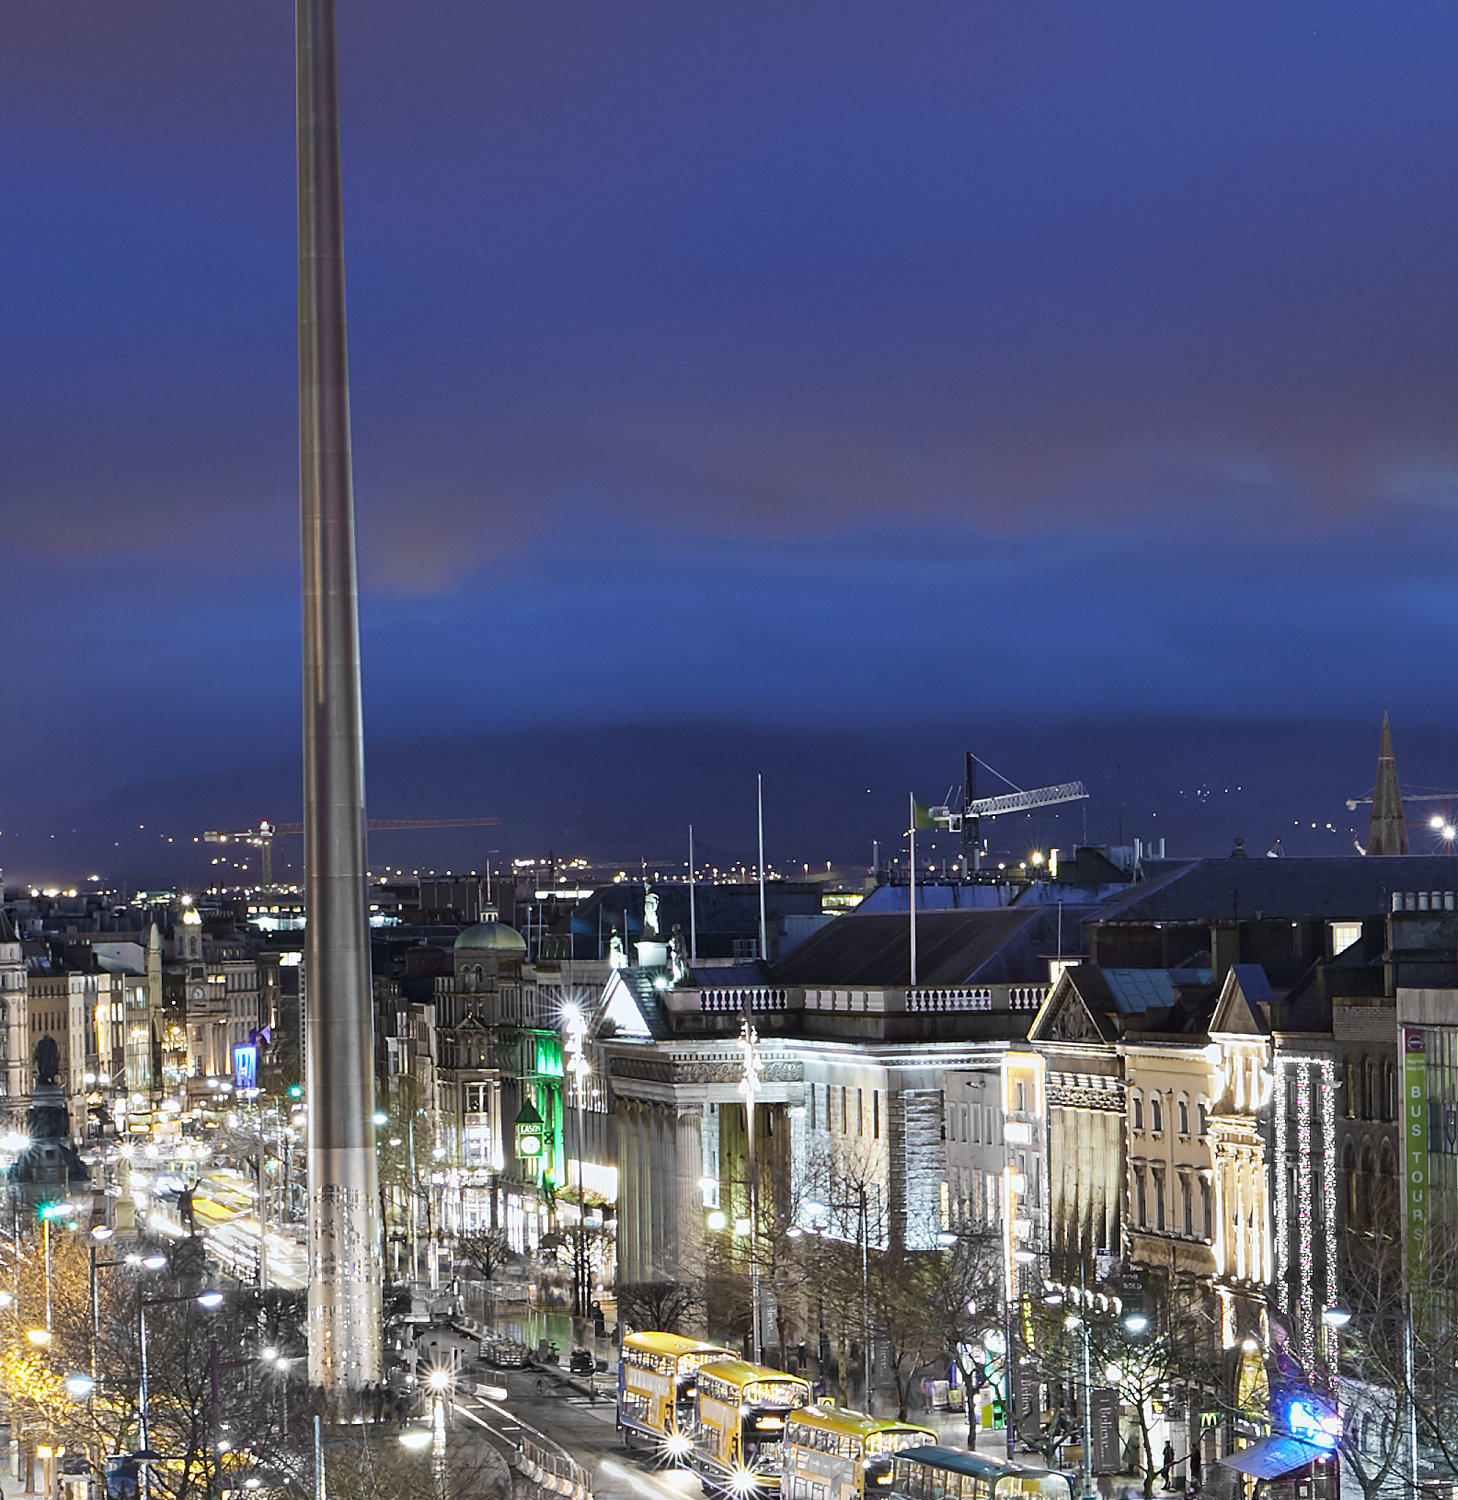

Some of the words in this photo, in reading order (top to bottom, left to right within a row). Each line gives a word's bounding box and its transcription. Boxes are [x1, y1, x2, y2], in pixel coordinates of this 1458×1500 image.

[521, 1125, 541, 1133] EASON
[1411, 1086, 1422, 1137] BUS
[1411, 1152, 1424, 1241] TOURS
